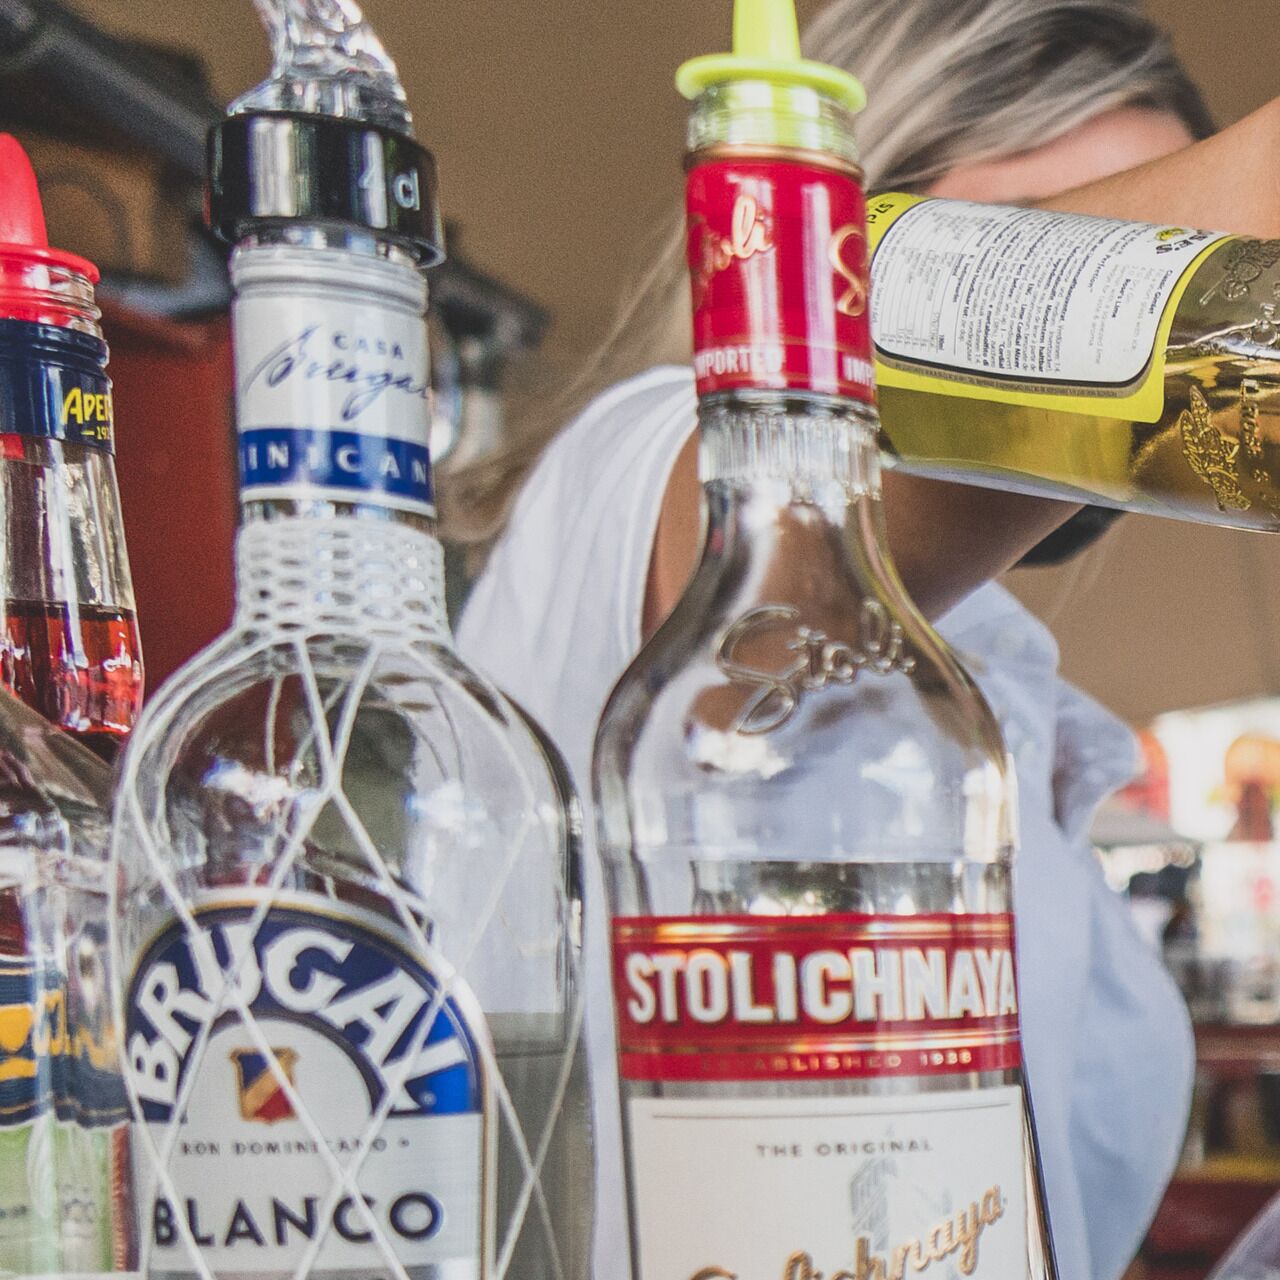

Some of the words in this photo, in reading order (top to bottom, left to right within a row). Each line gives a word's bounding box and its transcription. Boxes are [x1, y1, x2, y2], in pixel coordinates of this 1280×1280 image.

[391, 168, 421, 212] cl
[625, 947, 1018, 1024] STOLICHNAYA
[920, 1050, 973, 1067] 1938
[183, 1139, 220, 1156] RON
[756, 1144, 802, 1158] THE
[816, 1139, 934, 1157] ORIGINAL
[153, 1191, 444, 1247] BLANCO
